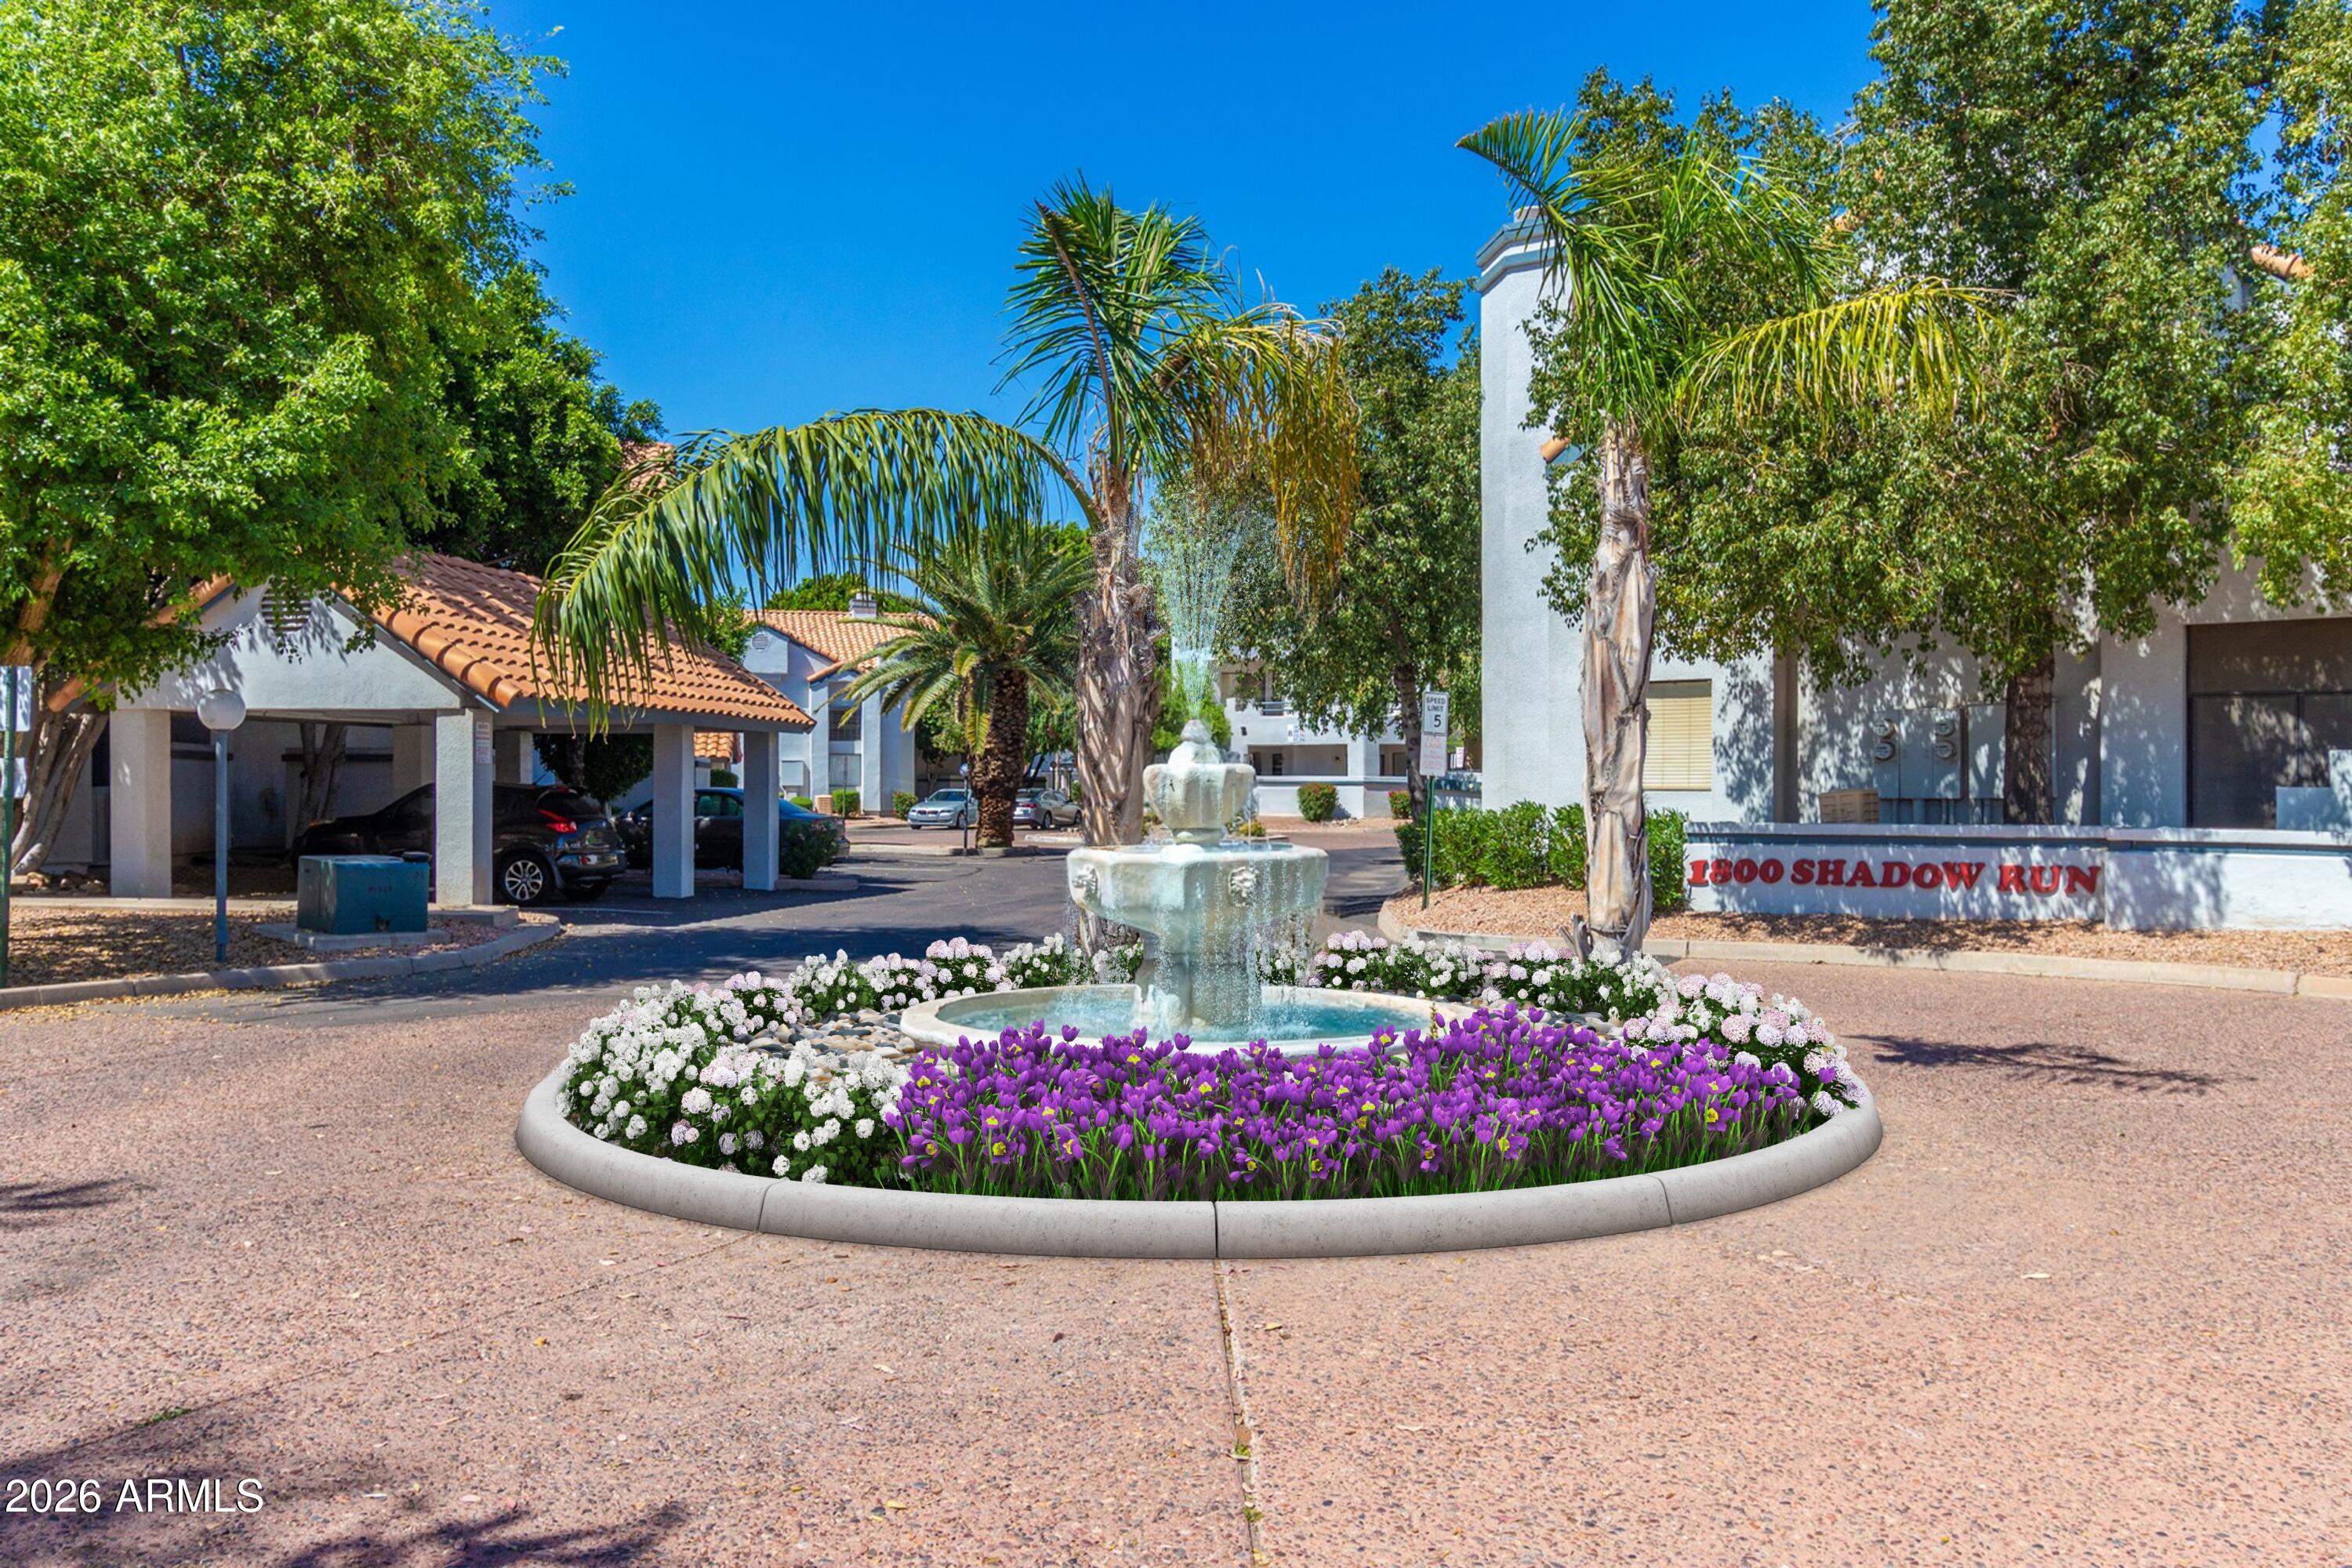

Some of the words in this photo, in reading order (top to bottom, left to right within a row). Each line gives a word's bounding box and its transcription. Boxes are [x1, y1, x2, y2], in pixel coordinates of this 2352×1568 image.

[1426, 696, 1446, 705] SPEED
[1433, 714, 1442, 728] 5
[1687, 858, 1785, 886] 1800
[1790, 858, 1987, 892] SHADOW
[1997, 864, 2102, 895] RUN
